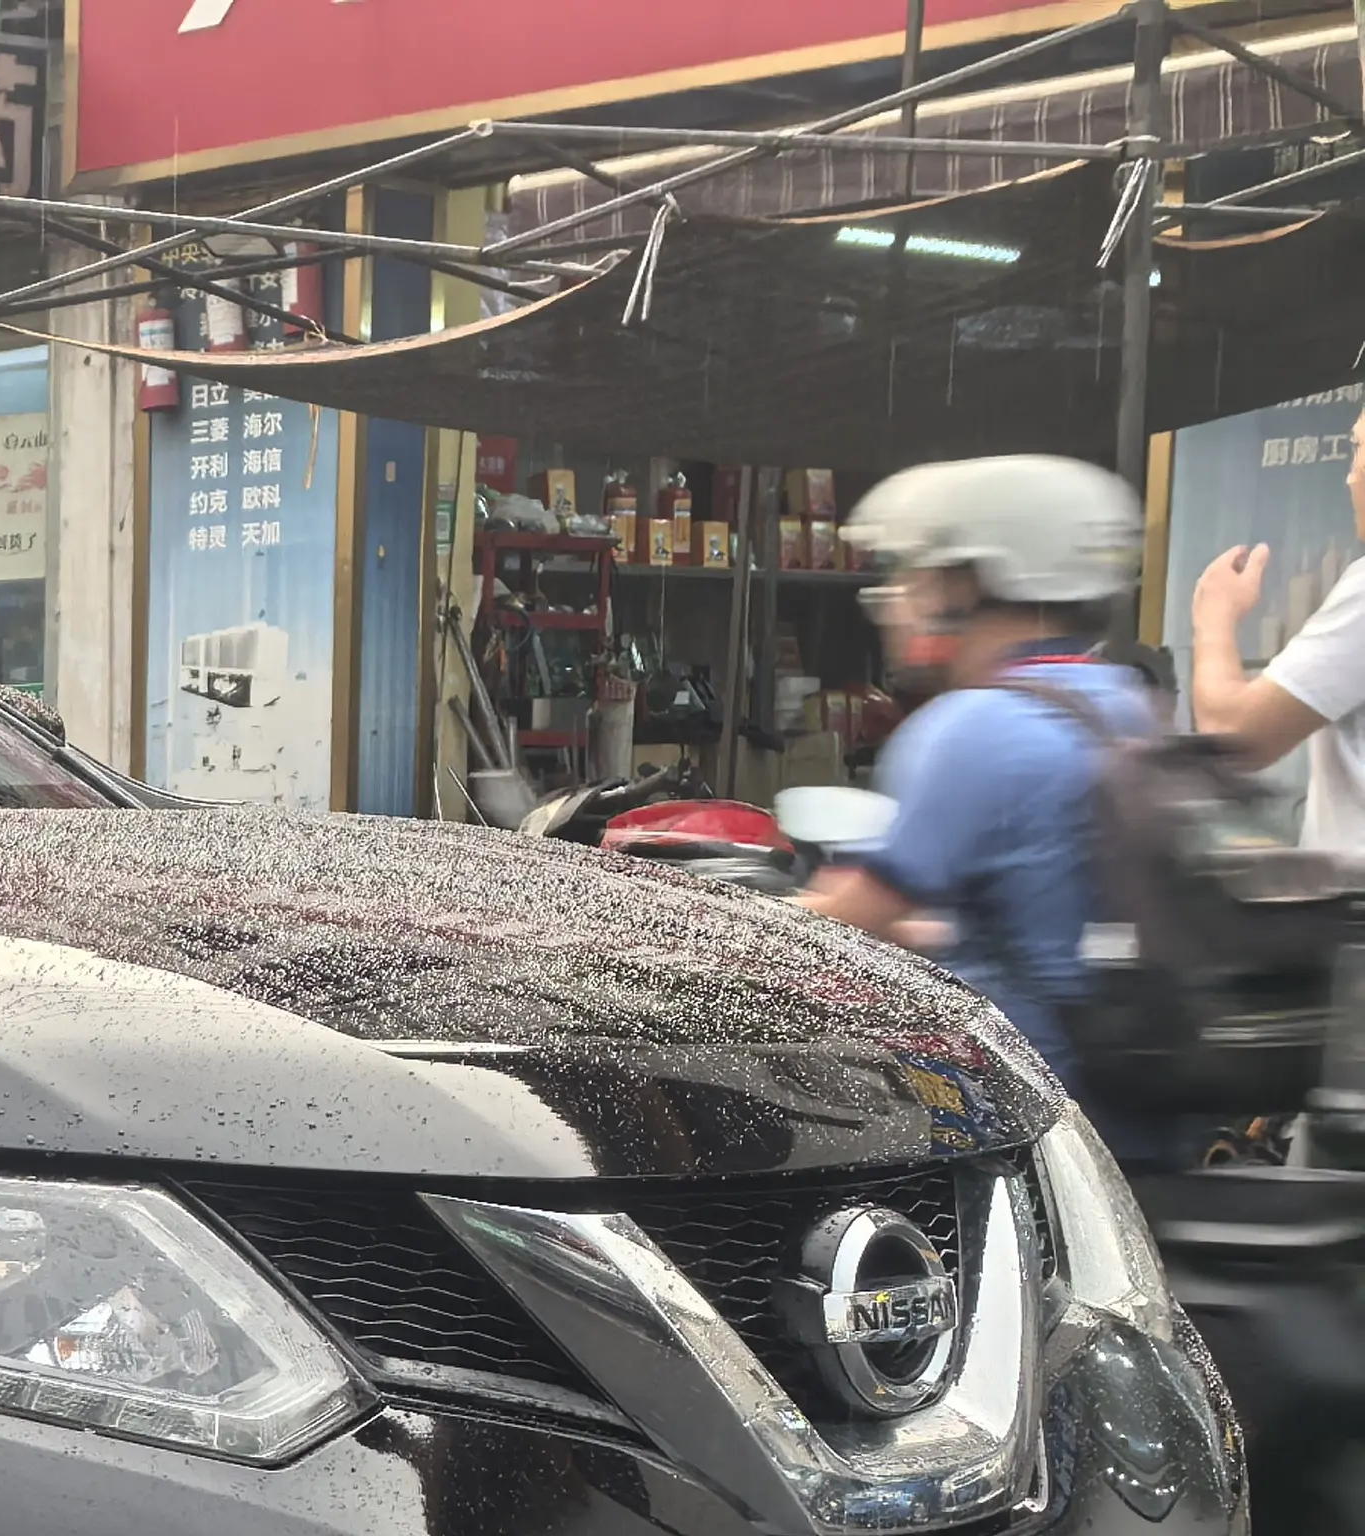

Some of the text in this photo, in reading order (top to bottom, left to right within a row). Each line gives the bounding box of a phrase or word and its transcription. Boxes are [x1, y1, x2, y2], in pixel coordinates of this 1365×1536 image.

[191, 383, 229, 408] 日立
[190, 411, 282, 444] 三菱 海尔
[189, 447, 282, 480] 开利 海信
[241, 520, 281, 547] 天加
